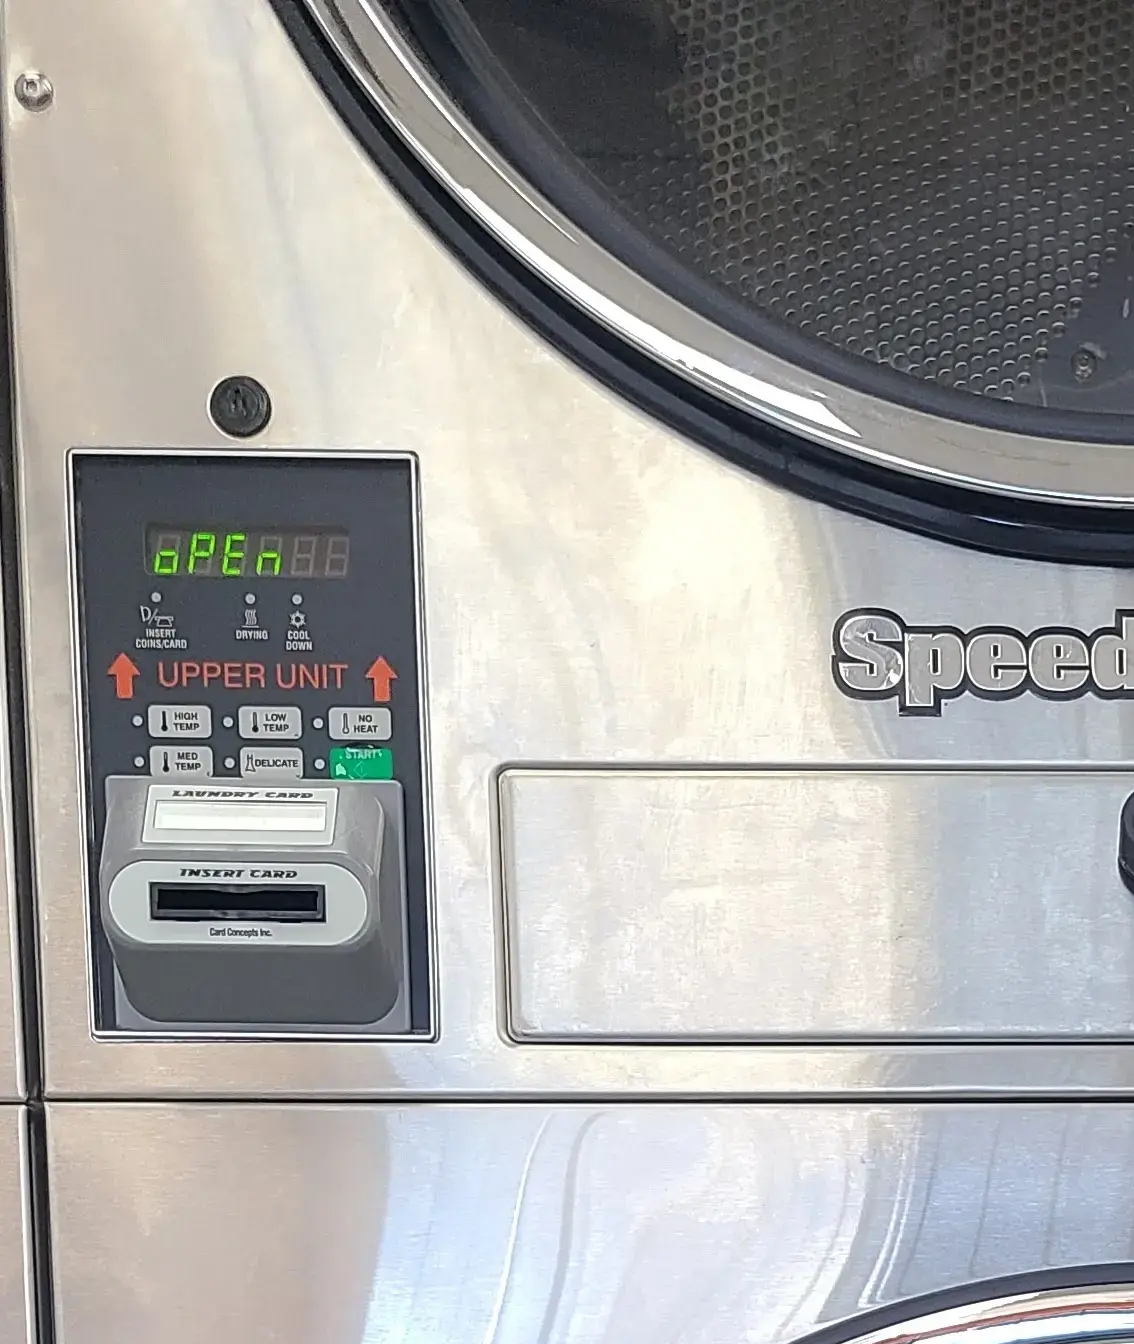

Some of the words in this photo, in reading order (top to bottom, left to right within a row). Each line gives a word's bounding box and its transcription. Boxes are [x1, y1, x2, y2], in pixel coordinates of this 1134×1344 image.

[145, 628, 177, 638] INSERT
[235, 630, 269, 640] DRYING
[287, 630, 311, 640] COOL
[135, 638, 188, 650] COINS/CARD
[285, 641, 313, 651] DOWN
[157, 661, 266, 688] UPPER
[275, 663, 349, 690] UNIT
[173, 711, 199, 721] HIGH
[264, 713, 287, 723] LOW
[357, 714, 374, 724] NO
[172, 722, 200, 732] TEMP
[262, 723, 290, 733] TEMP
[352, 724, 379, 734] HEAT
[176, 752, 199, 761] MED
[344, 747, 377, 760] START
[174, 761, 202, 771] TEMP
[254, 758, 300, 769] DELICATE
[171, 789, 260, 799] LAUNDRY
[264, 791, 314, 799] CARD
[179, 868, 245, 878] INSERT
[249, 869, 298, 879] CARD
[209, 927, 226, 937] Card
[226, 927, 258, 939] Concepts
[259, 928, 273, 938] Inc.
